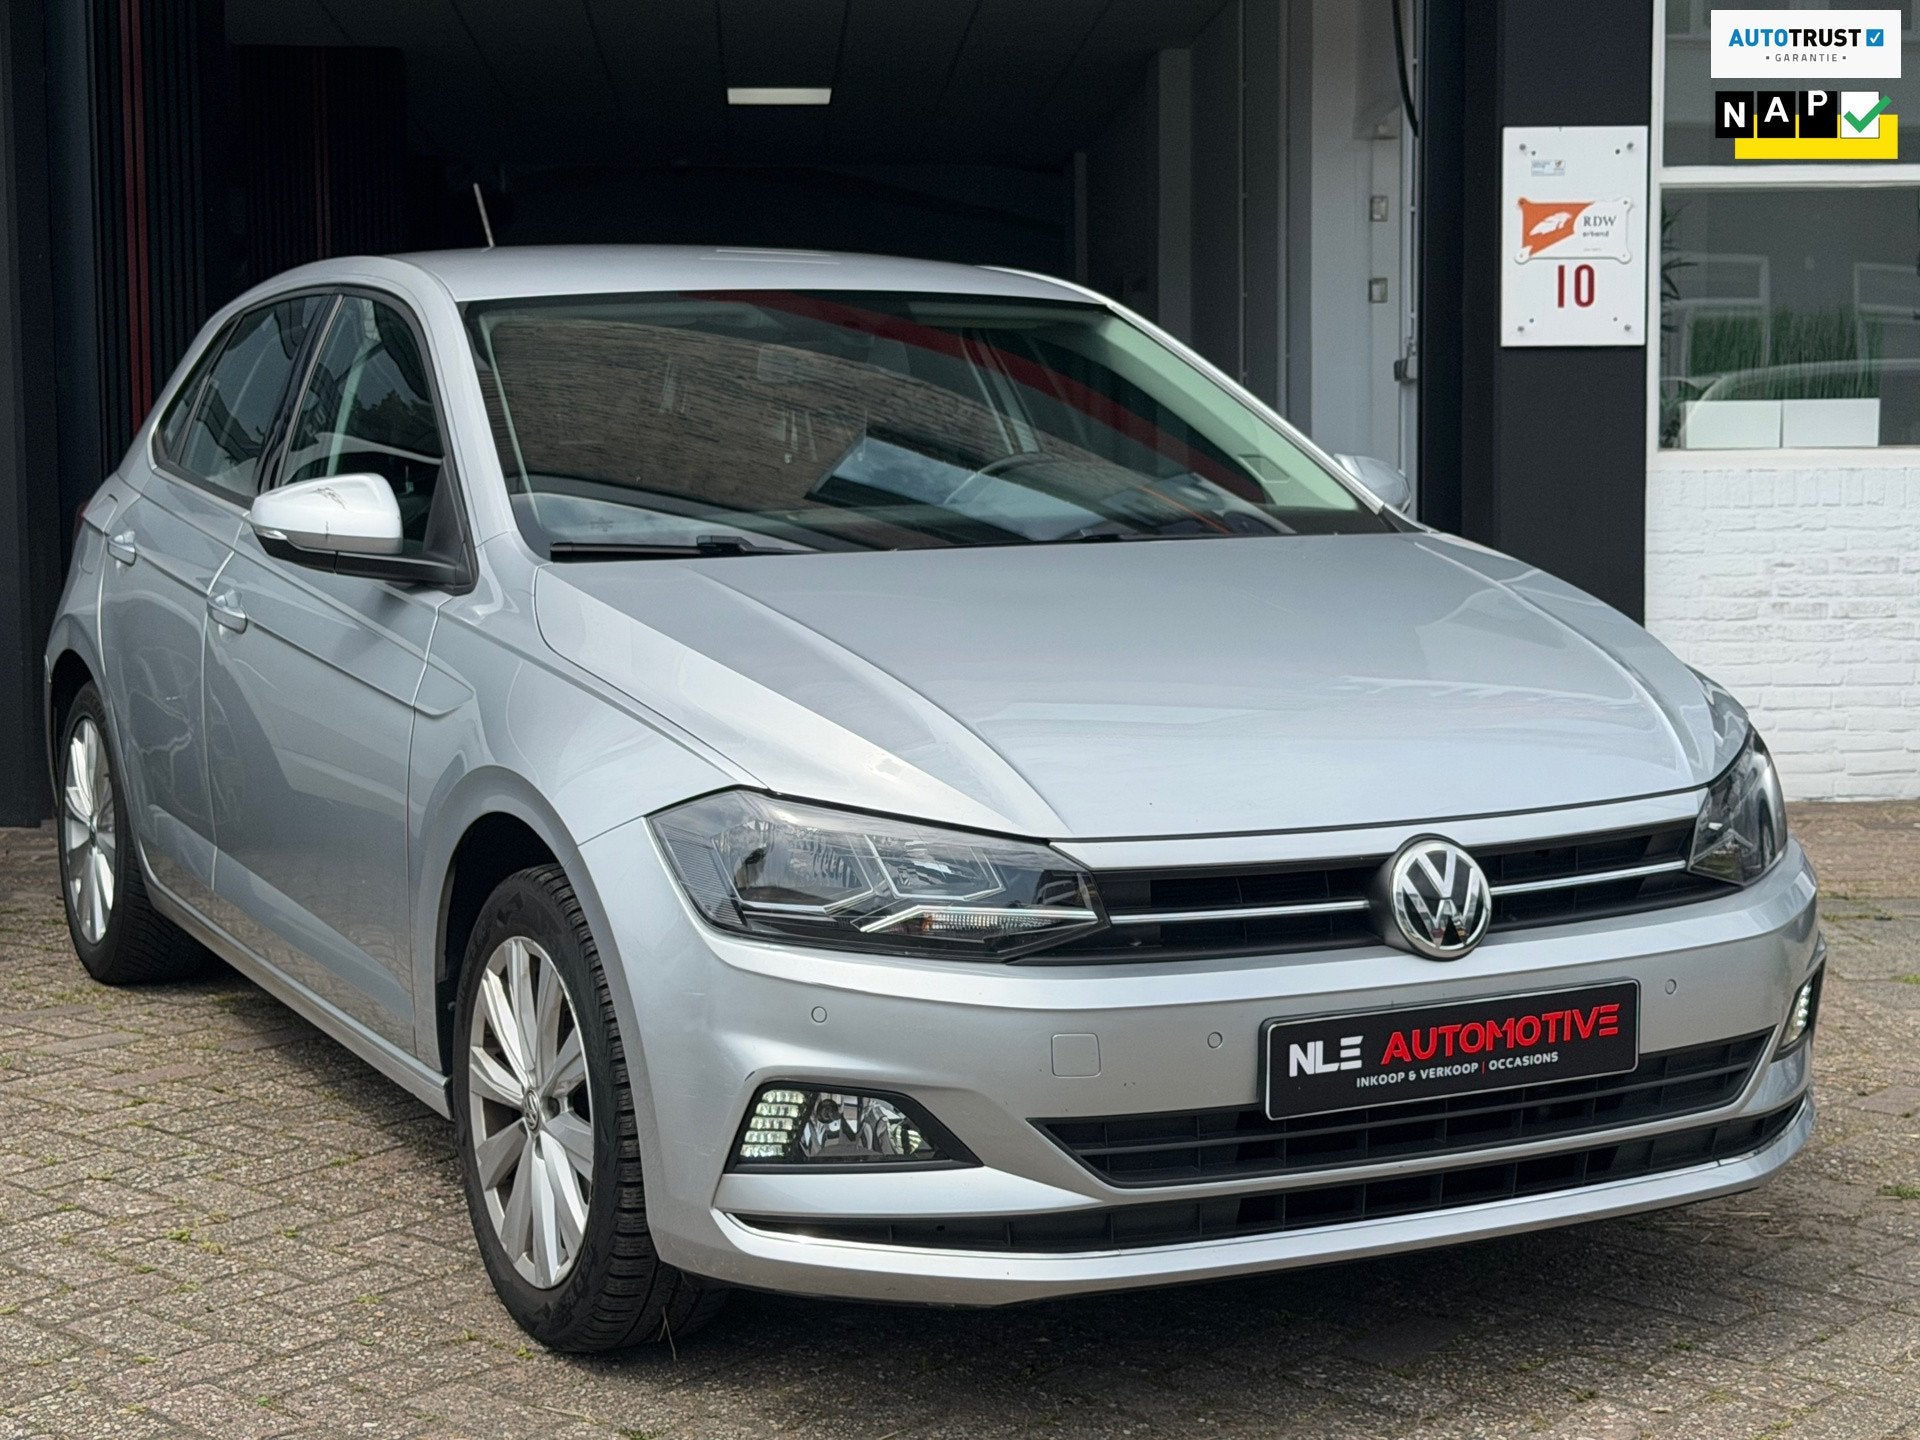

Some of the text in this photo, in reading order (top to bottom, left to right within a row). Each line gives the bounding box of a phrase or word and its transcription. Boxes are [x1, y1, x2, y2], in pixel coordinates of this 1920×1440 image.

[1583, 215, 1617, 227] RDW
[1557, 264, 1595, 308] 10
[1289, 1003, 1620, 1078] NLE AUTOMOTIVE
[1356, 1051, 1559, 1088] INKOOP & VERKOOP OCCASIONS
